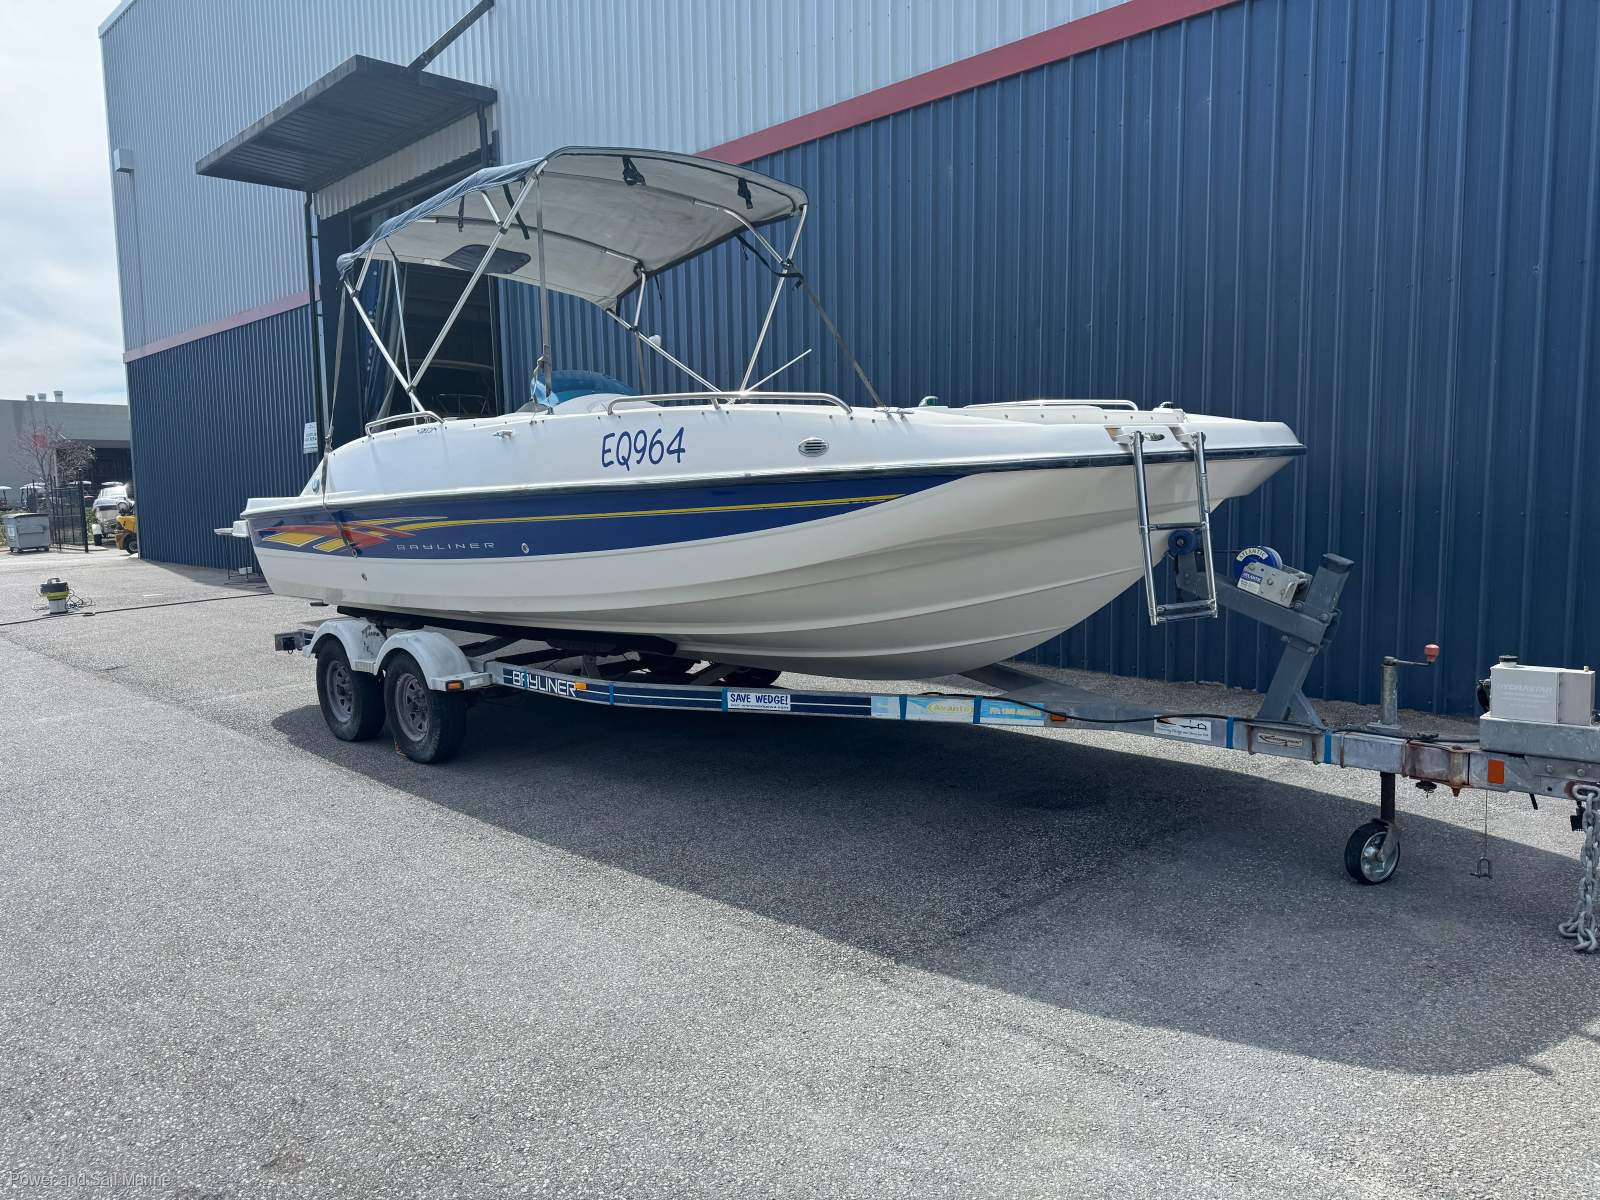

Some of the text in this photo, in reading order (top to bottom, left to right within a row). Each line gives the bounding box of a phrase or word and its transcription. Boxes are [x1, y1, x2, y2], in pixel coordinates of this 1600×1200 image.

[601, 426, 686, 472] EQ964
[396, 542, 495, 551] BAYLINER
[512, 671, 577, 698] BAYLINER
[730, 693, 752, 703] SAVE
[755, 694, 789, 706] WEDGE!
